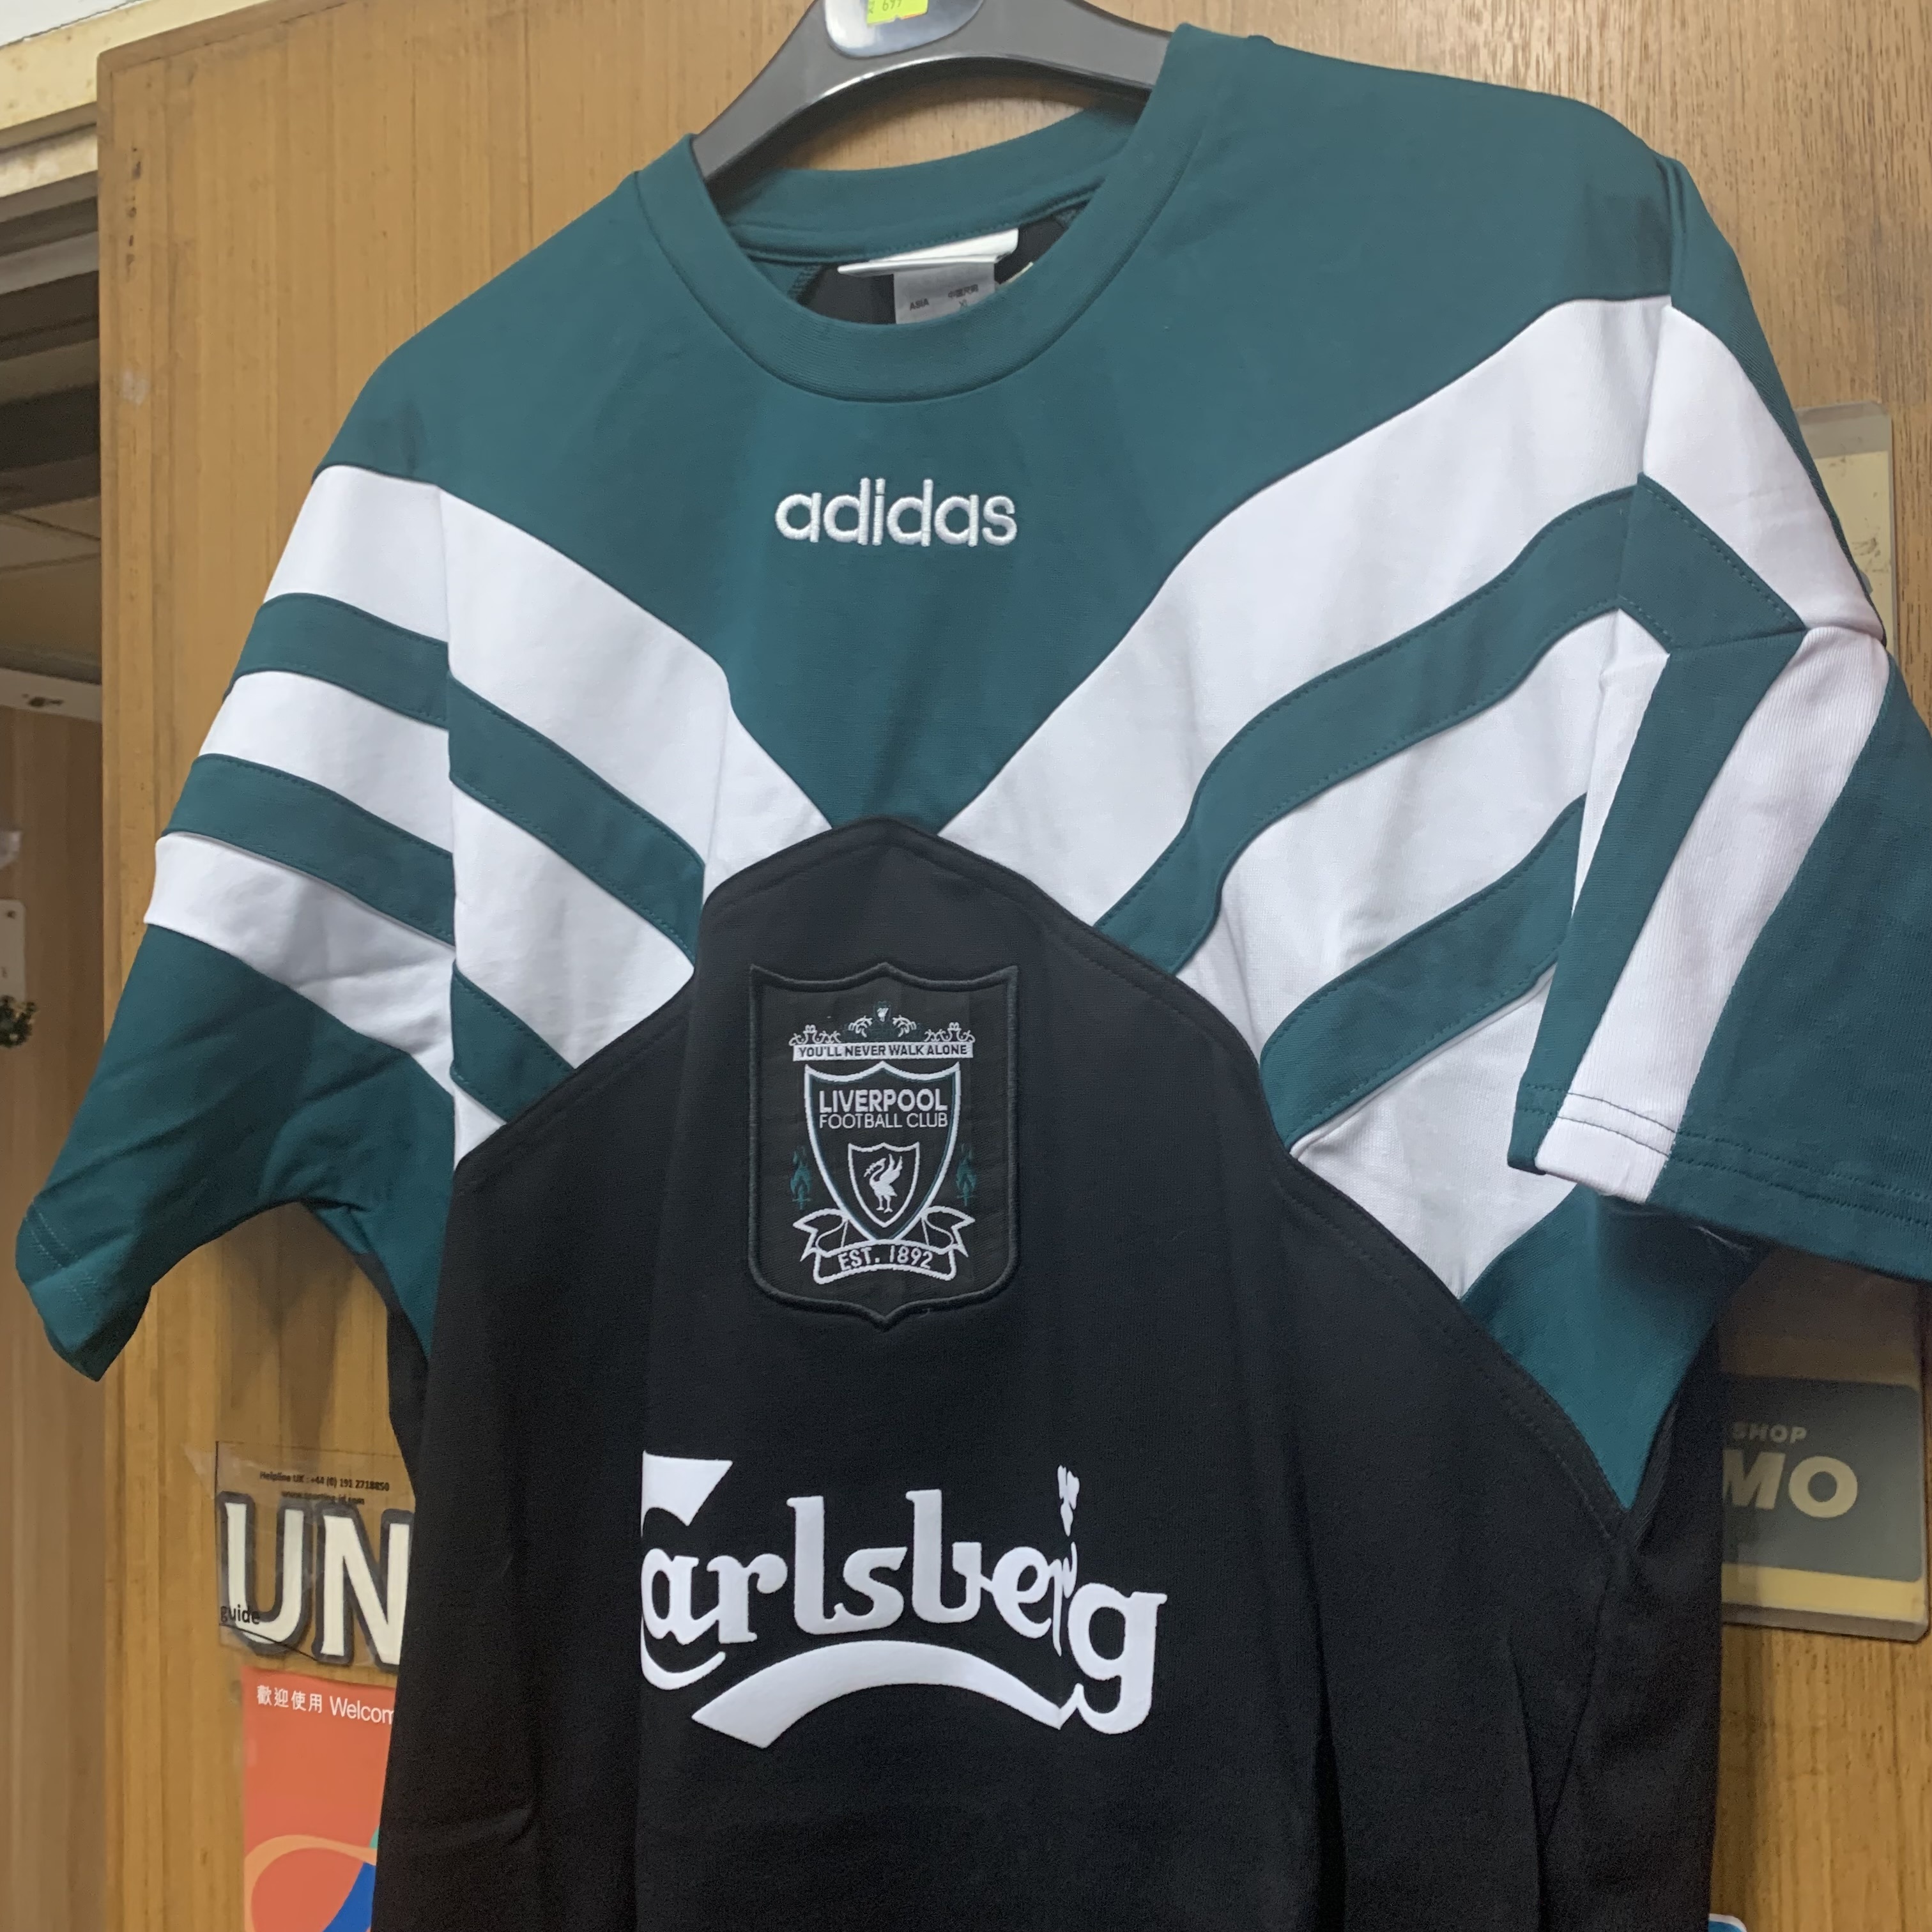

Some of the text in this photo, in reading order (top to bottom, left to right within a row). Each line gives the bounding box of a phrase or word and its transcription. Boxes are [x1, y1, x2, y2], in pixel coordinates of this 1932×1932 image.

[775, 477, 1017, 547] adidas
[799, 1044, 967, 1057] YOU'LL NEVER WALK ALONE
[819, 1089, 947, 1113] LIVERPOOL
[819, 1112, 947, 1129] FOOTBALL CLUB
[838, 1245, 933, 1271] EST. 1892
[1733, 1422, 1807, 1444] SHOP
[340, 1478, 353, 1488] 191
[220, 1604, 261, 1625] guide
[257, 1685, 323, 1713] 歡迎使用
